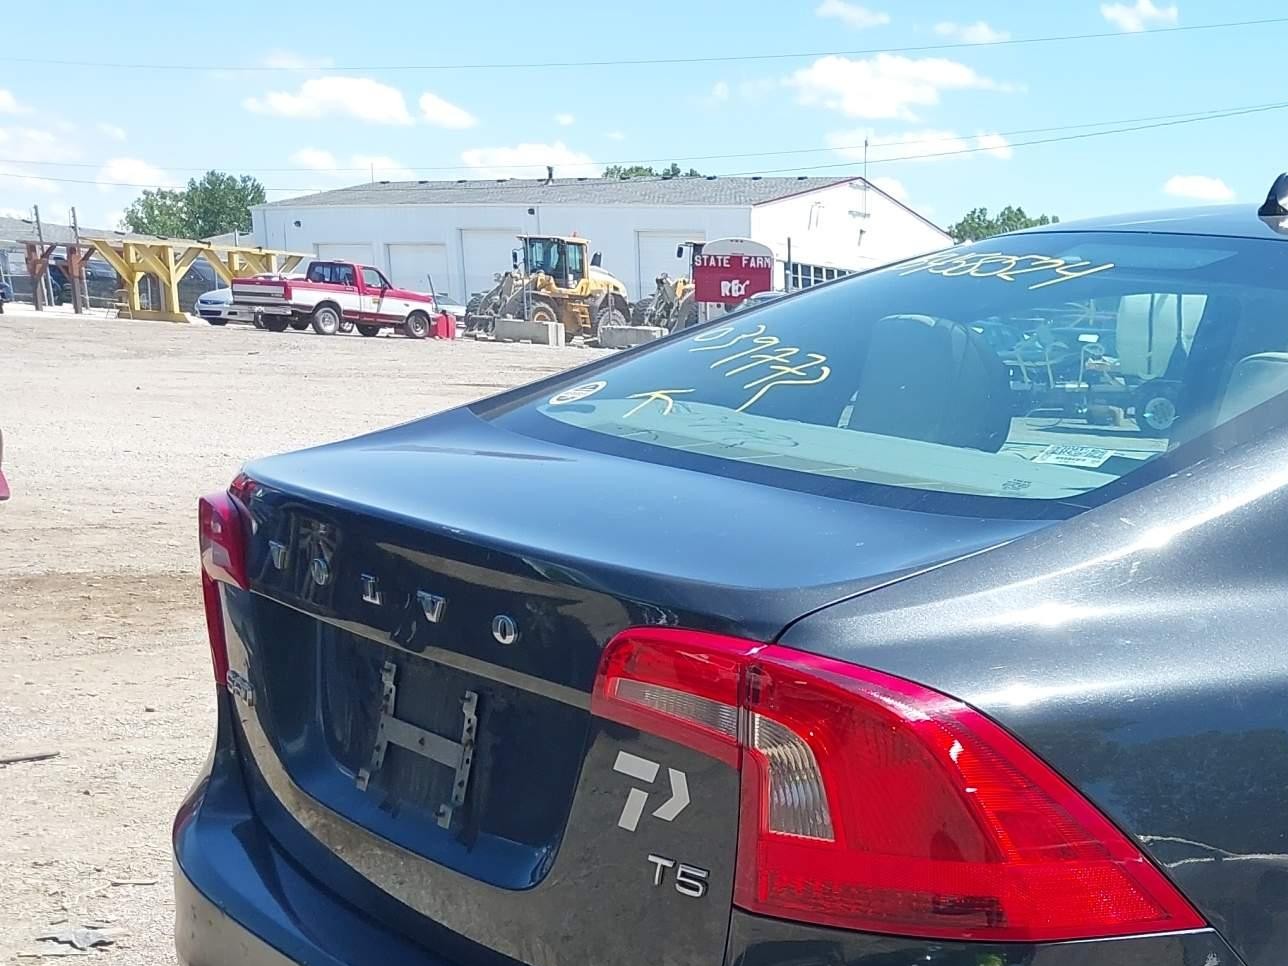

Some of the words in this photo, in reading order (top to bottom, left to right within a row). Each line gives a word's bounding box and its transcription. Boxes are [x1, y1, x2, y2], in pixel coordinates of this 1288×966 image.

[695, 255, 731, 267] STATE
[741, 256, 772, 268] FARM
[267, 539, 519, 646] VOLVO
[647, 853, 710, 899] T5
